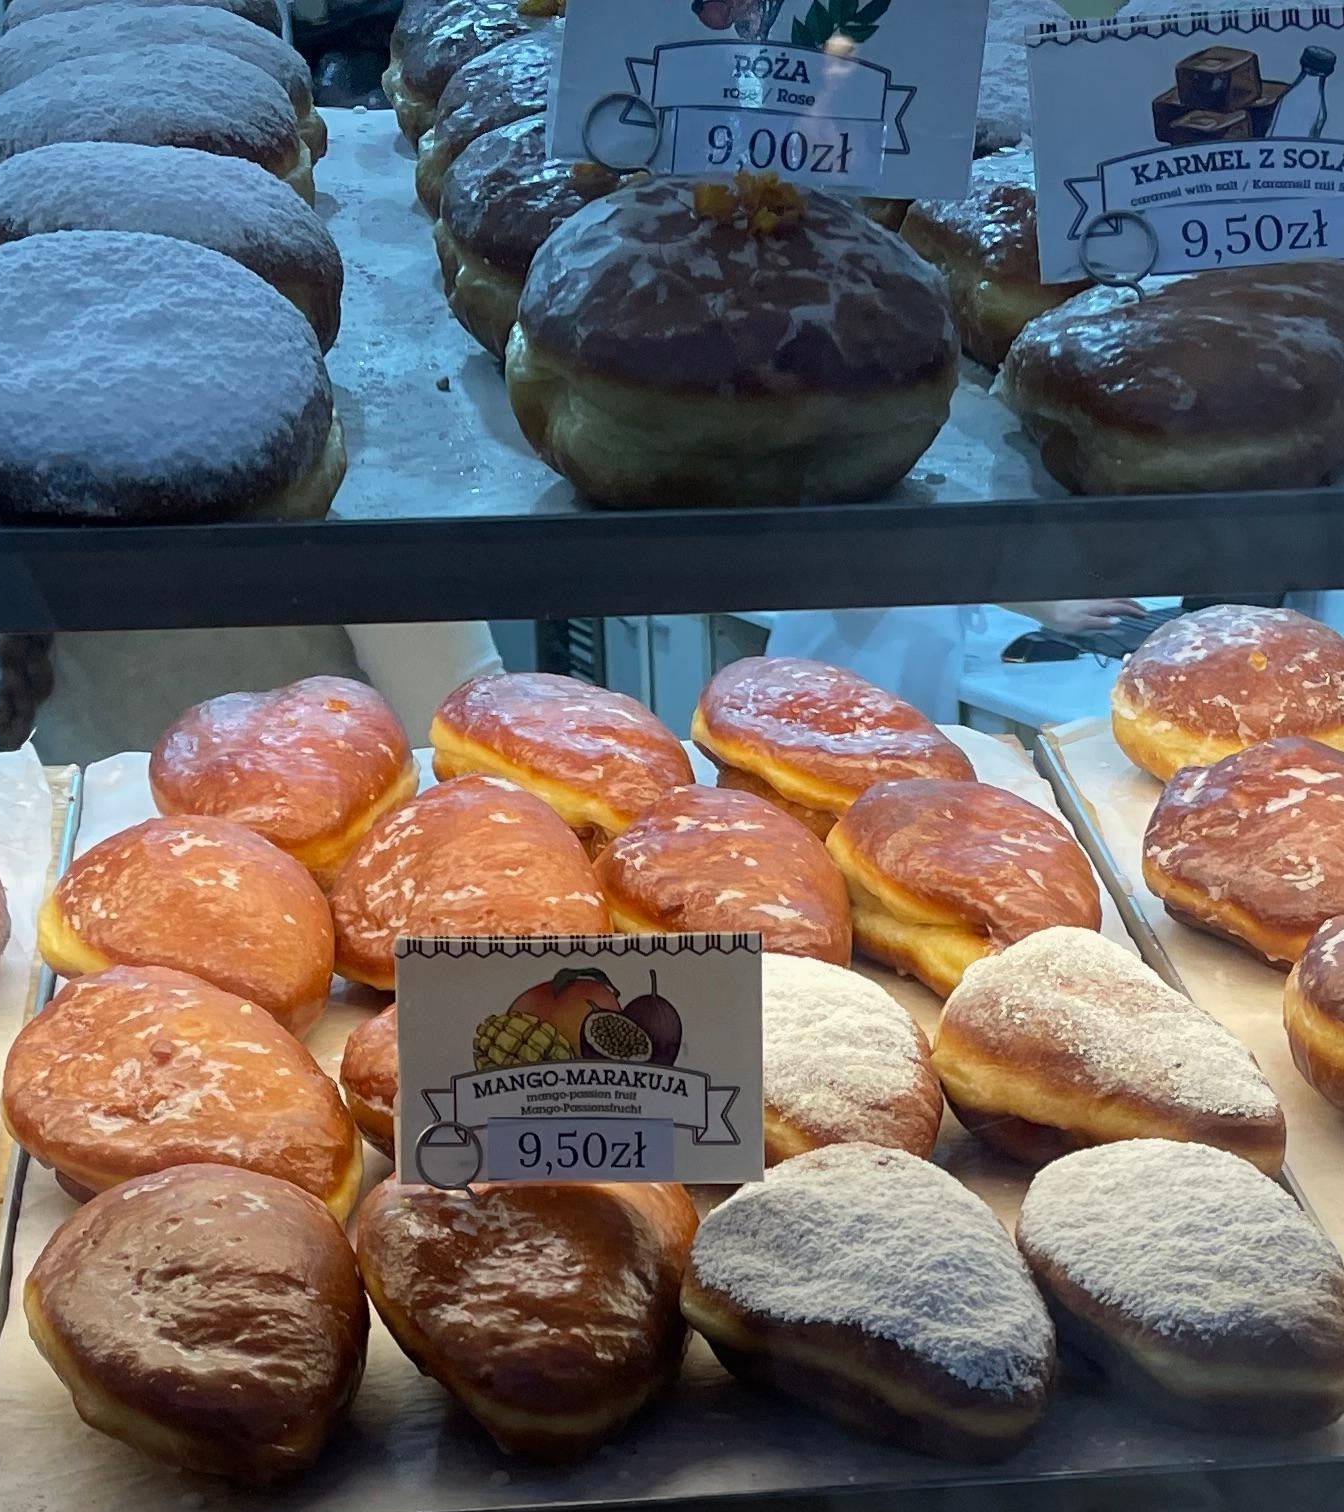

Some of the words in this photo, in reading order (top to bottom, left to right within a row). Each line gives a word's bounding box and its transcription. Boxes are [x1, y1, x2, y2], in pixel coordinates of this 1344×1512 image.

[733, 49, 810, 84] RÓŻA
[777, 88, 815, 106] Rose
[708, 124, 853, 174] 9,00zł
[1131, 150, 1251, 186] KARMEL
[1259, 149, 1274, 168] Z
[1130, 186, 1182, 207] caramel
[1185, 183, 1212, 196] with
[1216, 180, 1238, 192] salt
[1181, 208, 1328, 264] 9,50zł
[472, 1069, 689, 1099] MANGO-MARAKUJA
[518, 1130, 647, 1176] 9,50zł
